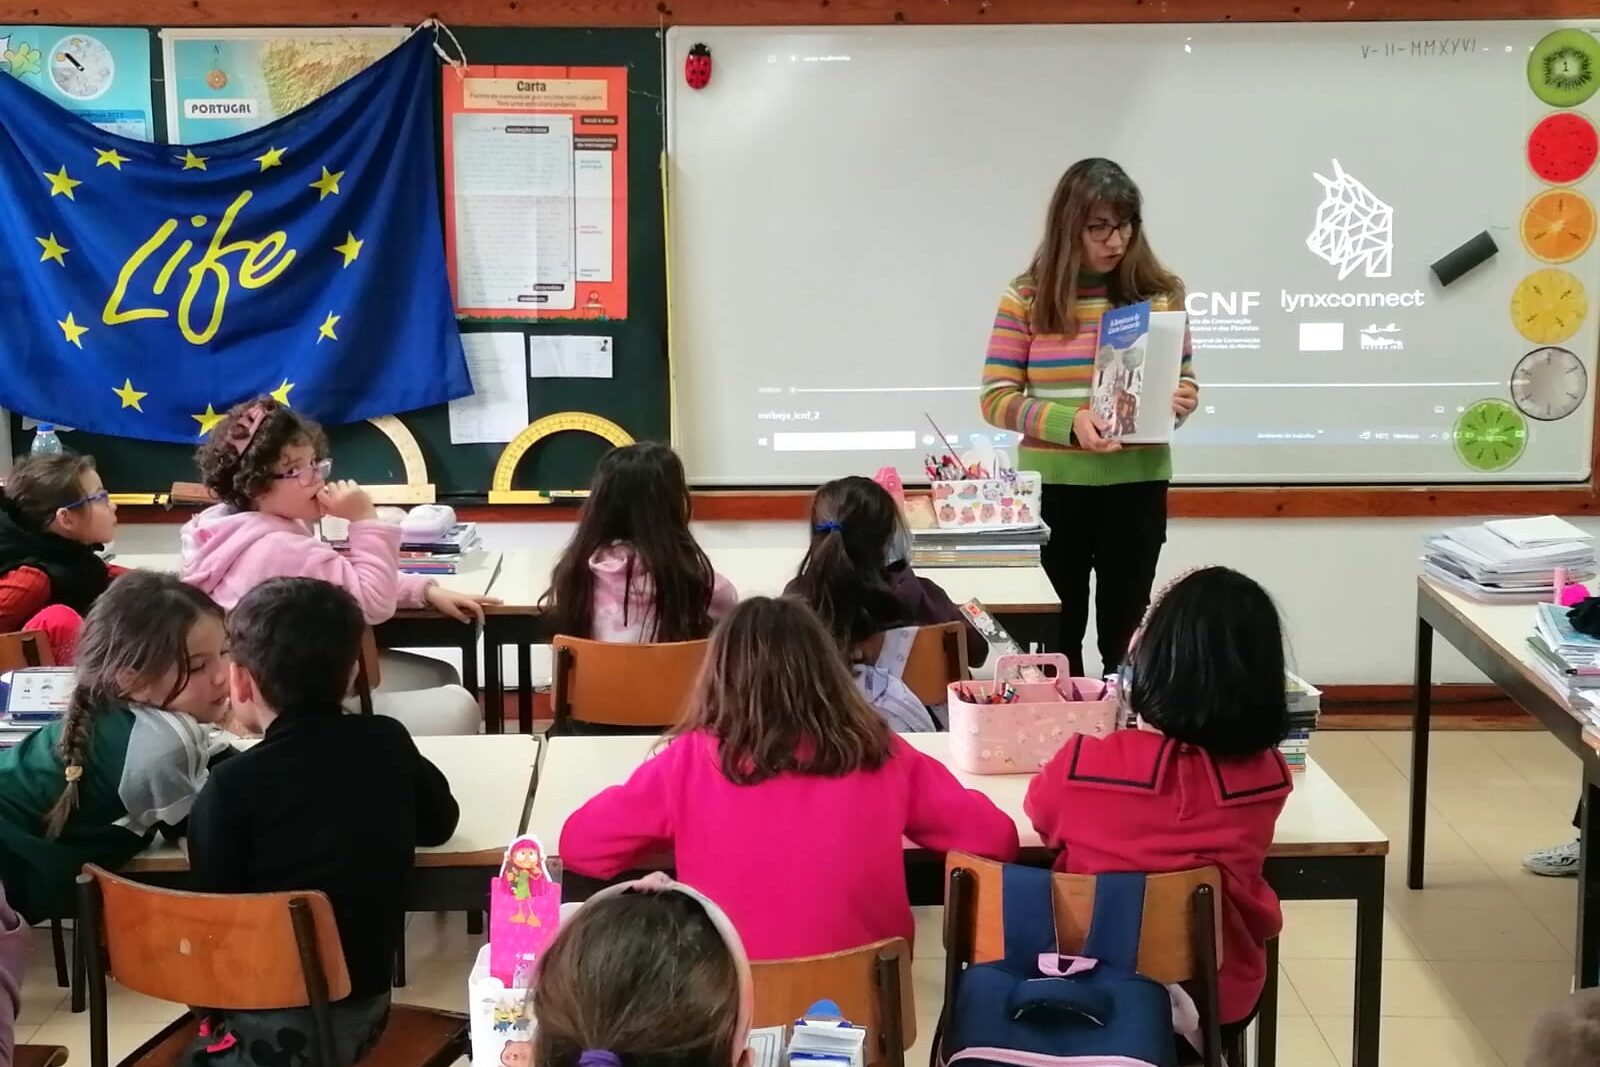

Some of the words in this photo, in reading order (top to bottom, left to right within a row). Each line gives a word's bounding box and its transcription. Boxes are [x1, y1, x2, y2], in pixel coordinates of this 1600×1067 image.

[516, 80, 547, 92] Carta
[191, 103, 251, 115] PORTUGAL
[102, 190, 297, 345] Life
[1280, 289, 1425, 313] lynxconnect
